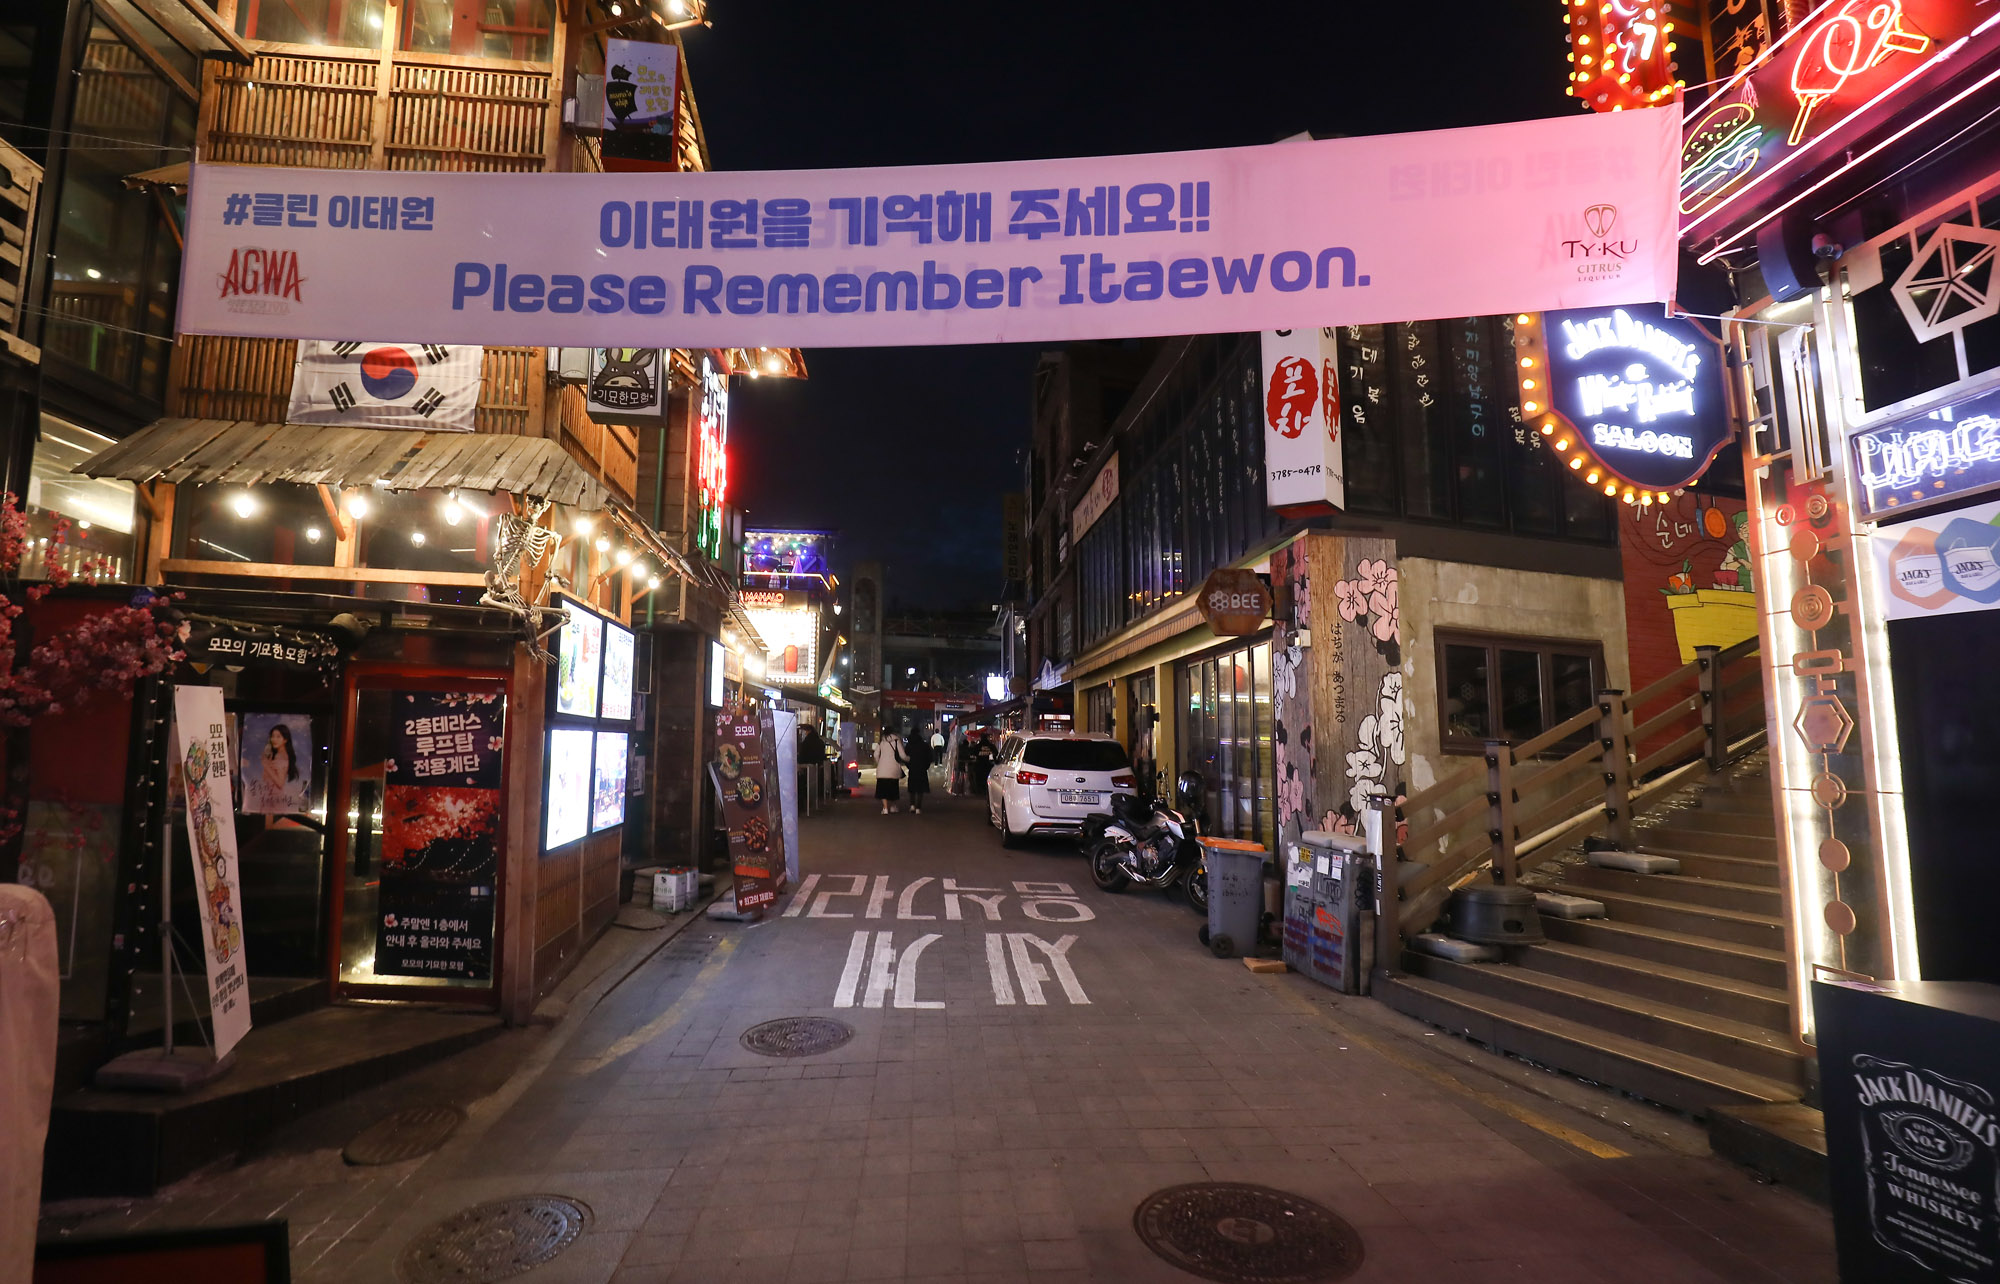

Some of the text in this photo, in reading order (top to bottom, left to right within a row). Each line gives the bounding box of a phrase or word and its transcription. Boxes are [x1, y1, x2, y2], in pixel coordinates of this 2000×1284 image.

[223, 193, 435, 231] #클린 이태원
[600, 181, 1211, 250] 이태원을 기억해 주세요!!
[219, 248, 304, 302] AGWA
[1577, 262, 1622, 274] CITRUS
[1578, 274, 1621, 282] LIQUEUR
[452, 245, 1372, 315] Please Remember Itaewon.
[597, 390, 650, 405] 기묘한모험
[1593, 422, 1693, 459] SALOON
[1271, 465, 1321, 481] 3785-0478
[1901, 569, 1932, 582] JACK'S
[1231, 593, 1261, 609] BEE
[208, 637, 308, 664] 모모의 기묘한 모험
[405, 713, 482, 735] 2층테라스
[735, 725, 756, 737] 모모의
[211, 741, 225, 760] 추천
[416, 732, 475, 756] 루프탑
[413, 754, 480, 777] 전용계단
[781, 873, 1097, 923] 음식거리
[401, 917, 468, 932] 주말엔 1층에서
[385, 934, 482, 950] 안내 후 올라와 주세요
[401, 959, 424, 969] 모모의
[833, 930, 1094, 1009] 세계
[1853, 1070, 2000, 1148] JACK DANIEL'S
[1882, 1151, 1982, 1204] Tennessee
[1886, 1181, 1983, 1231] WHISKEY
